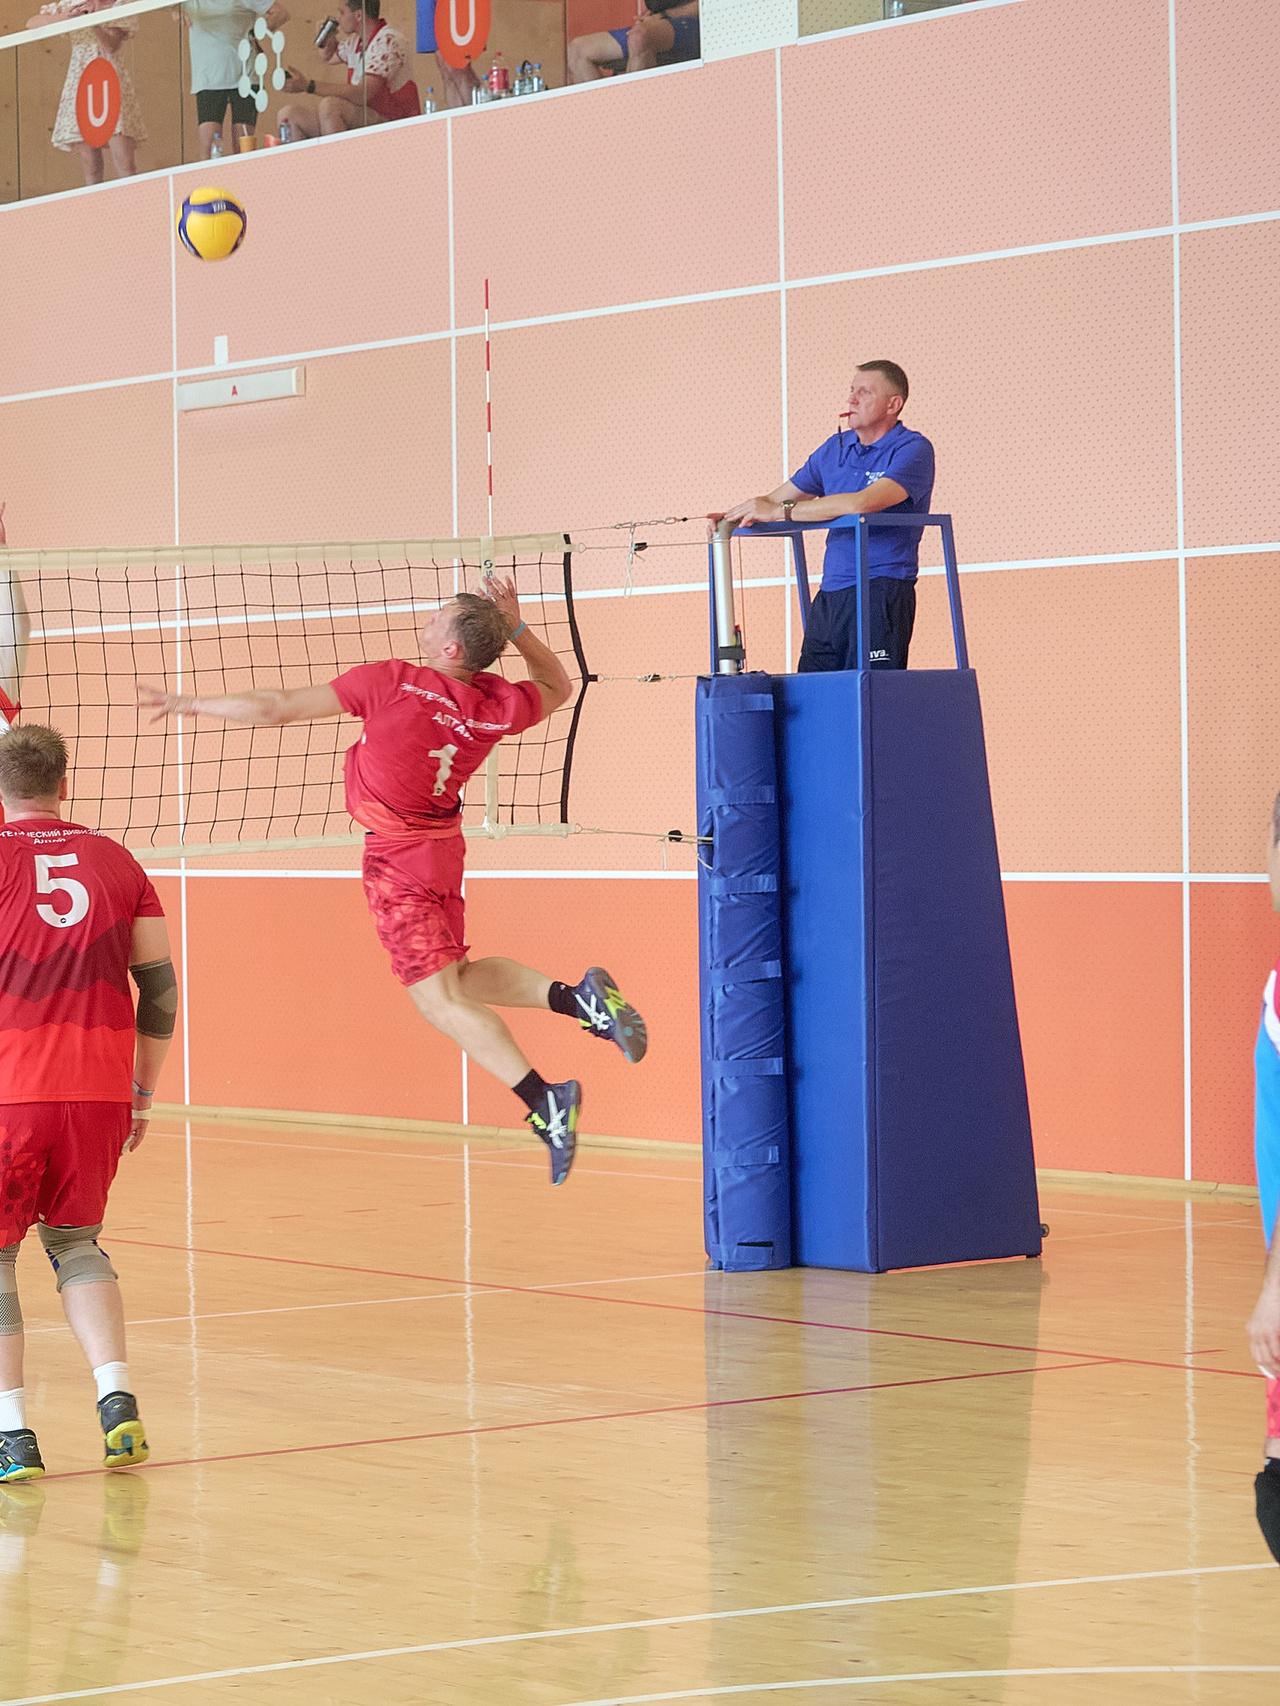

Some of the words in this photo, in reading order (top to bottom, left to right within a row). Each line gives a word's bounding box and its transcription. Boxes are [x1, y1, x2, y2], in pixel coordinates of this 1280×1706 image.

[87, 79, 109, 128] U
[427, 743, 459, 796] 1
[34, 852, 90, 928] 5
